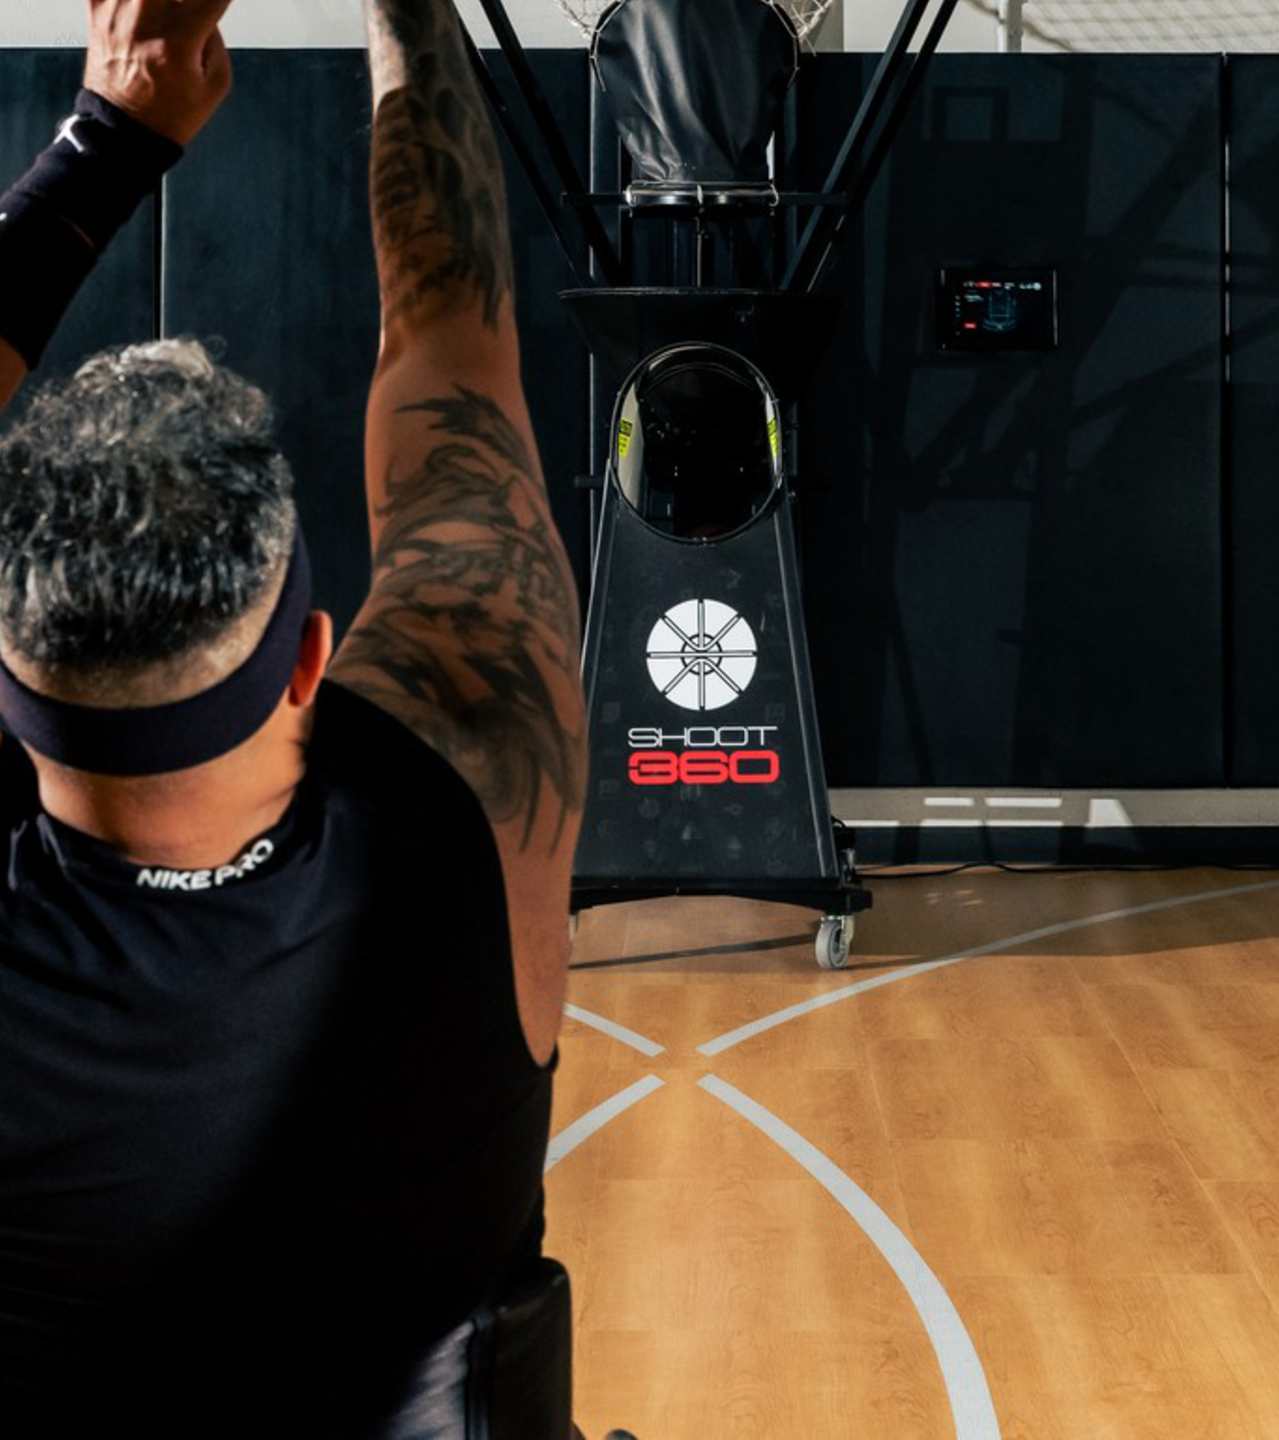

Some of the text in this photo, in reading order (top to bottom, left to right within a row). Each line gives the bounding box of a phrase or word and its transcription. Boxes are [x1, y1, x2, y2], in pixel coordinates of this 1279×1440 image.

[628, 726, 778, 748] SHOOT
[628, 750, 781, 785] 360
[136, 838, 275, 891] NIKE PRO
